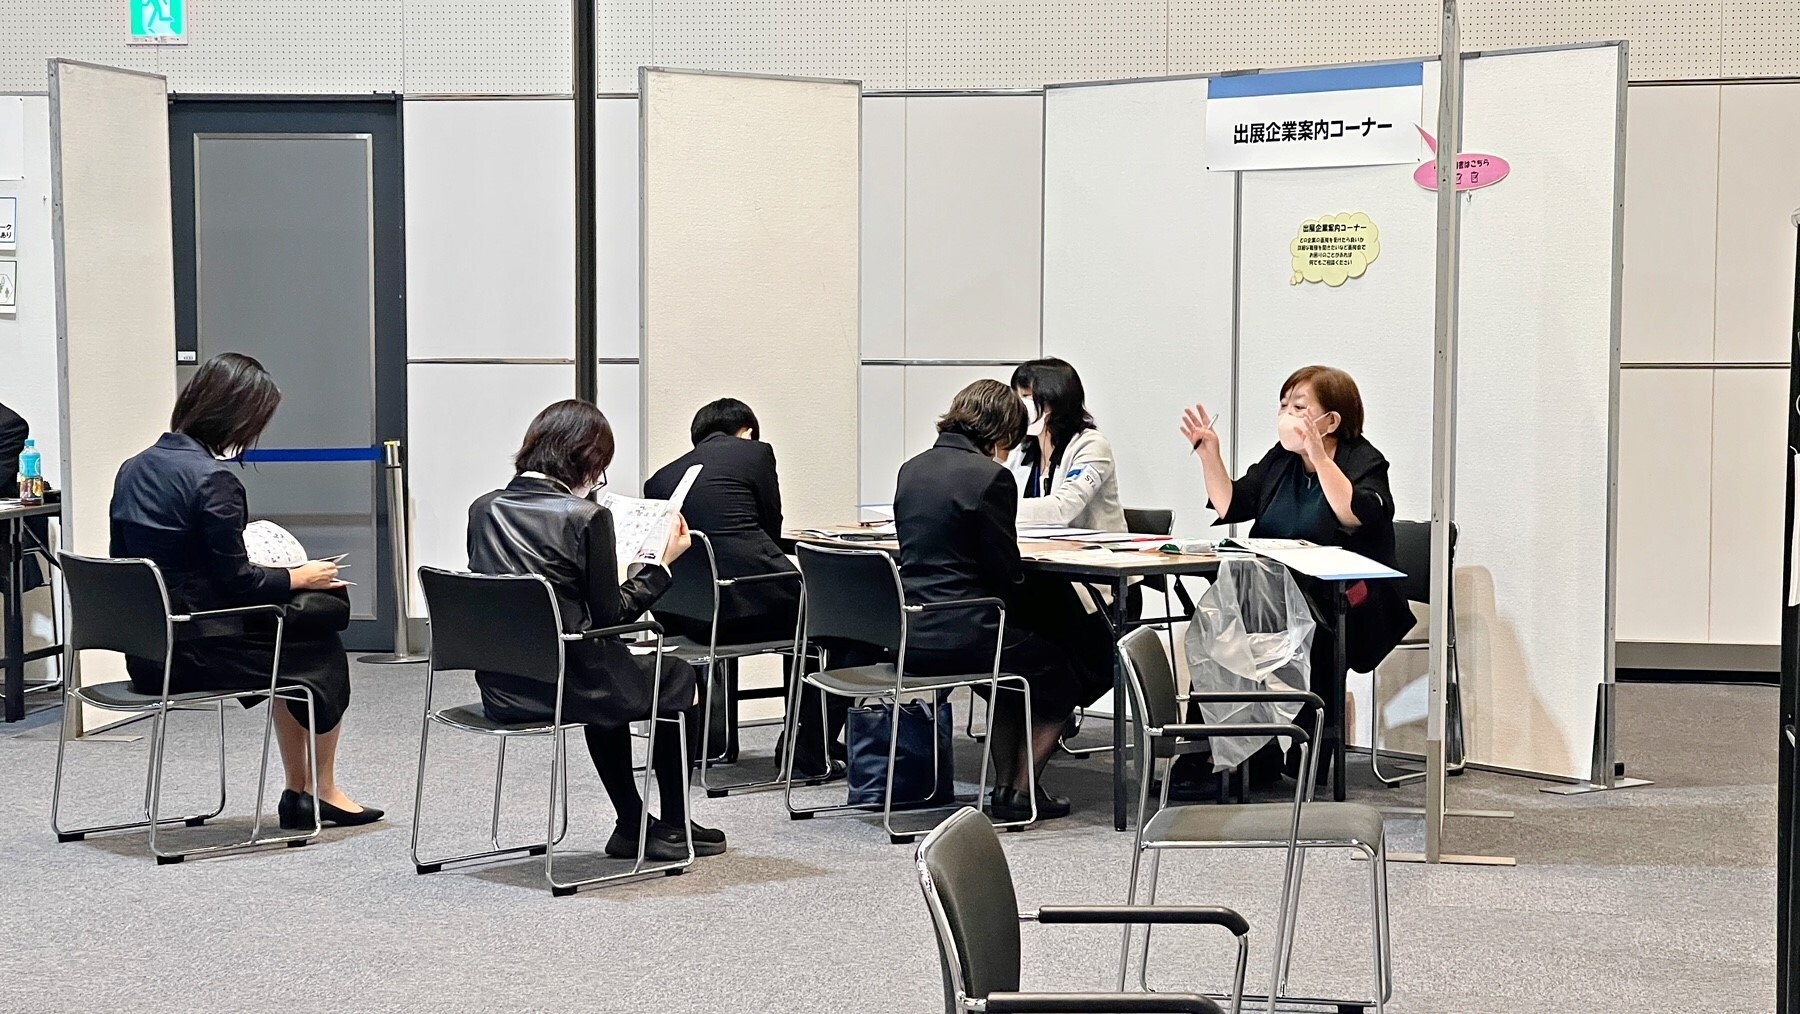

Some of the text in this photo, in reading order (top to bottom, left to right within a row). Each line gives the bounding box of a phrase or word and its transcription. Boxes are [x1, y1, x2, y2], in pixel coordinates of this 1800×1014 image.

[1233, 117, 1393, 144] 出展企業案内コーナー
[1303, 224, 1367, 232] 出展企業案内コーナー
